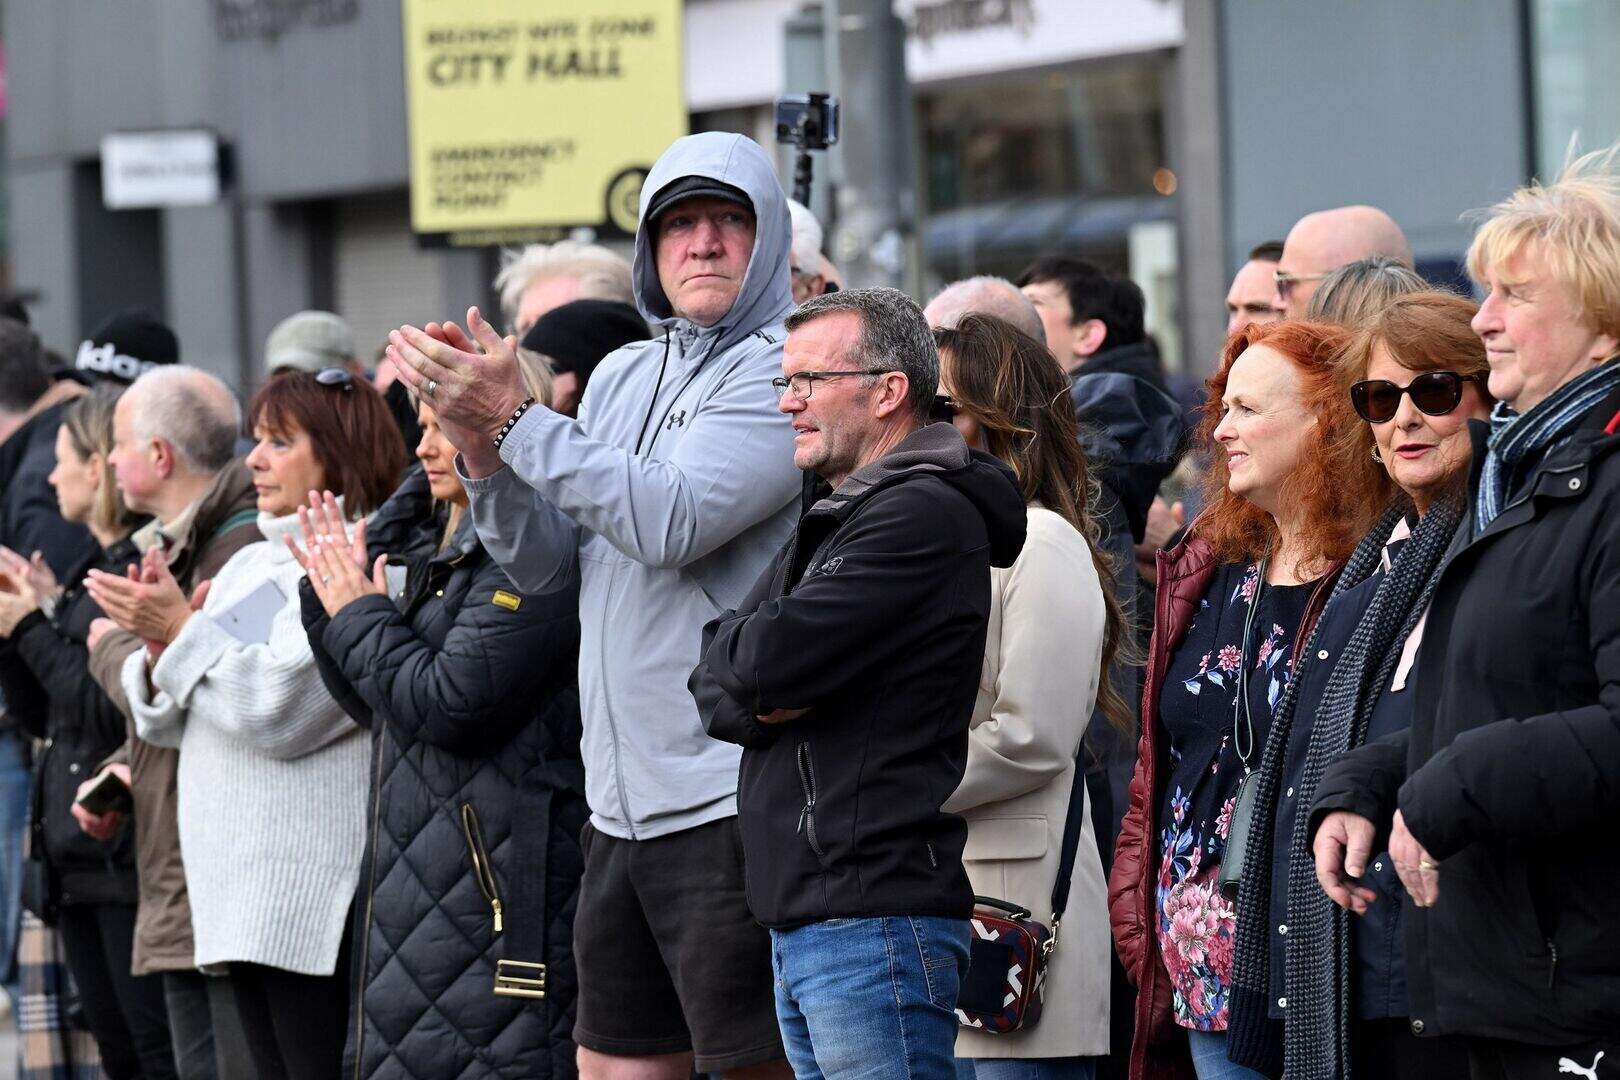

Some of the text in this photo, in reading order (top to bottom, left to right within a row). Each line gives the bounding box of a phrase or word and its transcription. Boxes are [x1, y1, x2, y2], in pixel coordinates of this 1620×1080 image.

[427, 47, 621, 86] CITY HALL
[431, 139, 576, 162] EMERGENCY
